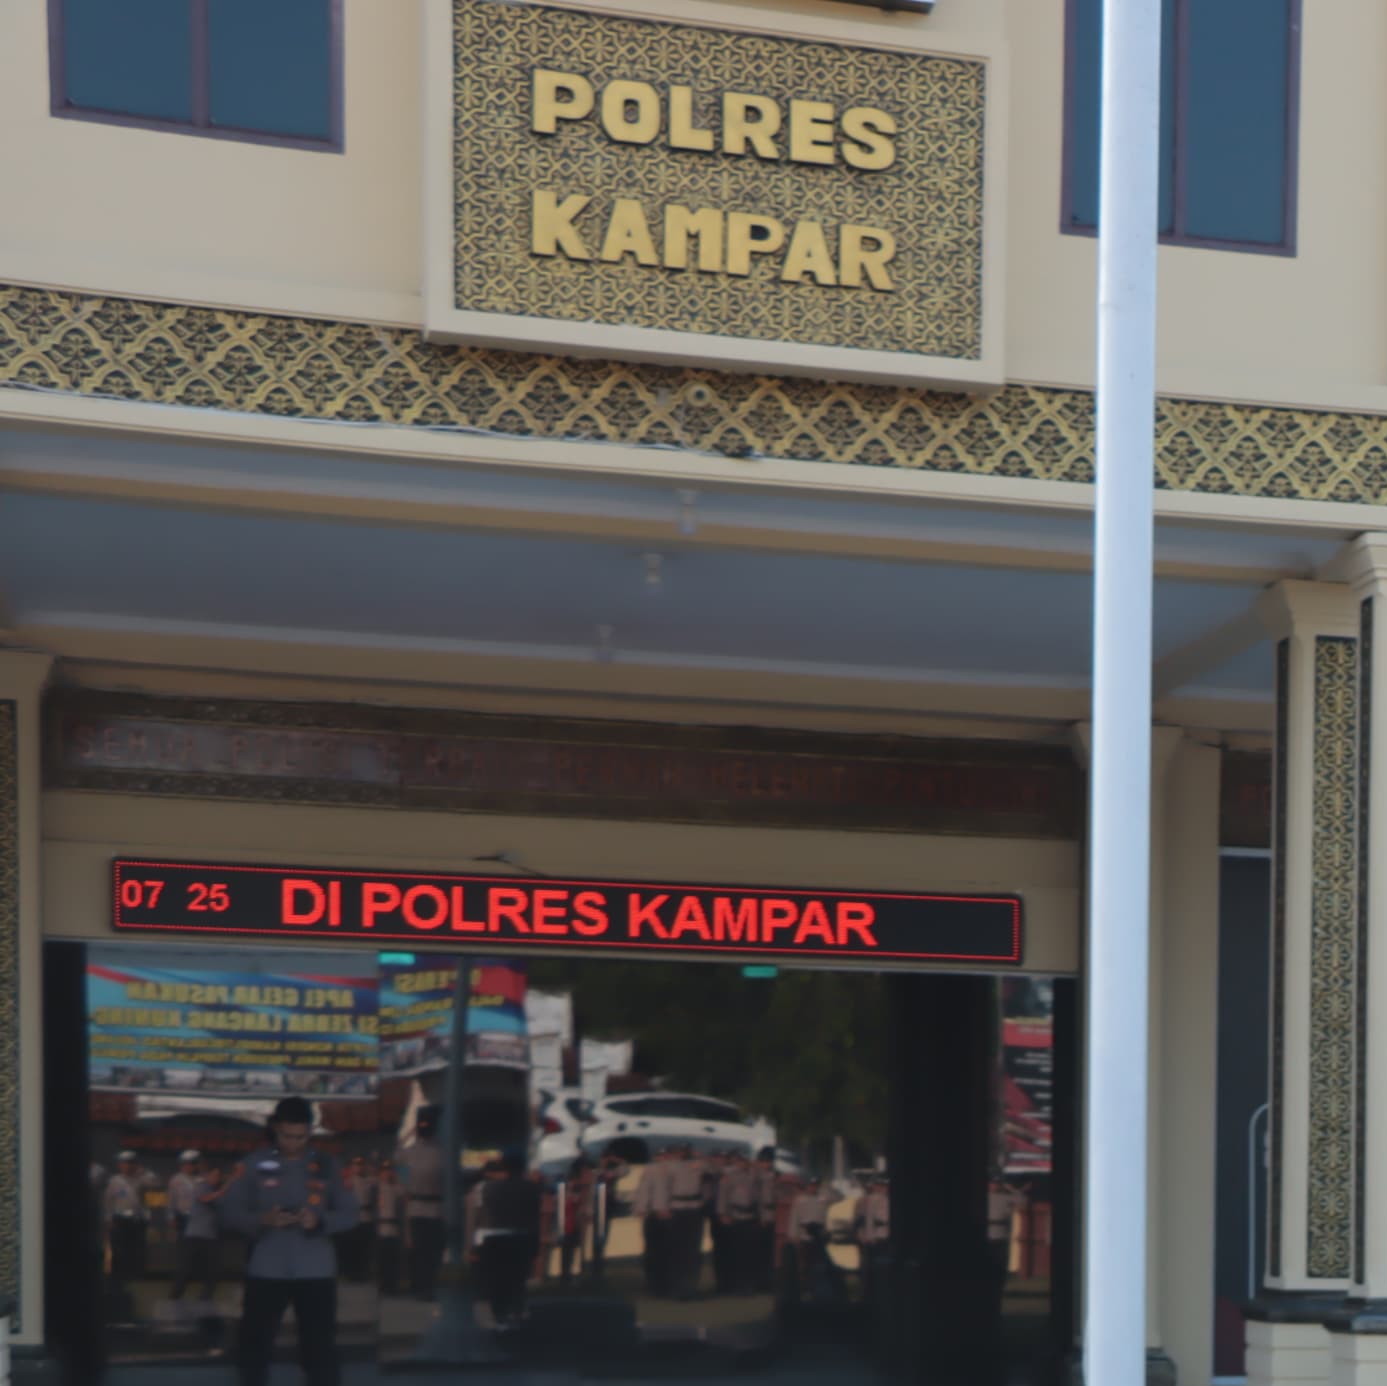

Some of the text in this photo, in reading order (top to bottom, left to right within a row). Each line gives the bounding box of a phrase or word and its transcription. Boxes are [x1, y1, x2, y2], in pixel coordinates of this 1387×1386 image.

[531, 68, 898, 172] POLRES
[530, 189, 897, 292] KAMPAR
[121, 880, 229, 911] 07 25
[282, 879, 878, 946] DI POLRES KAMPAR
